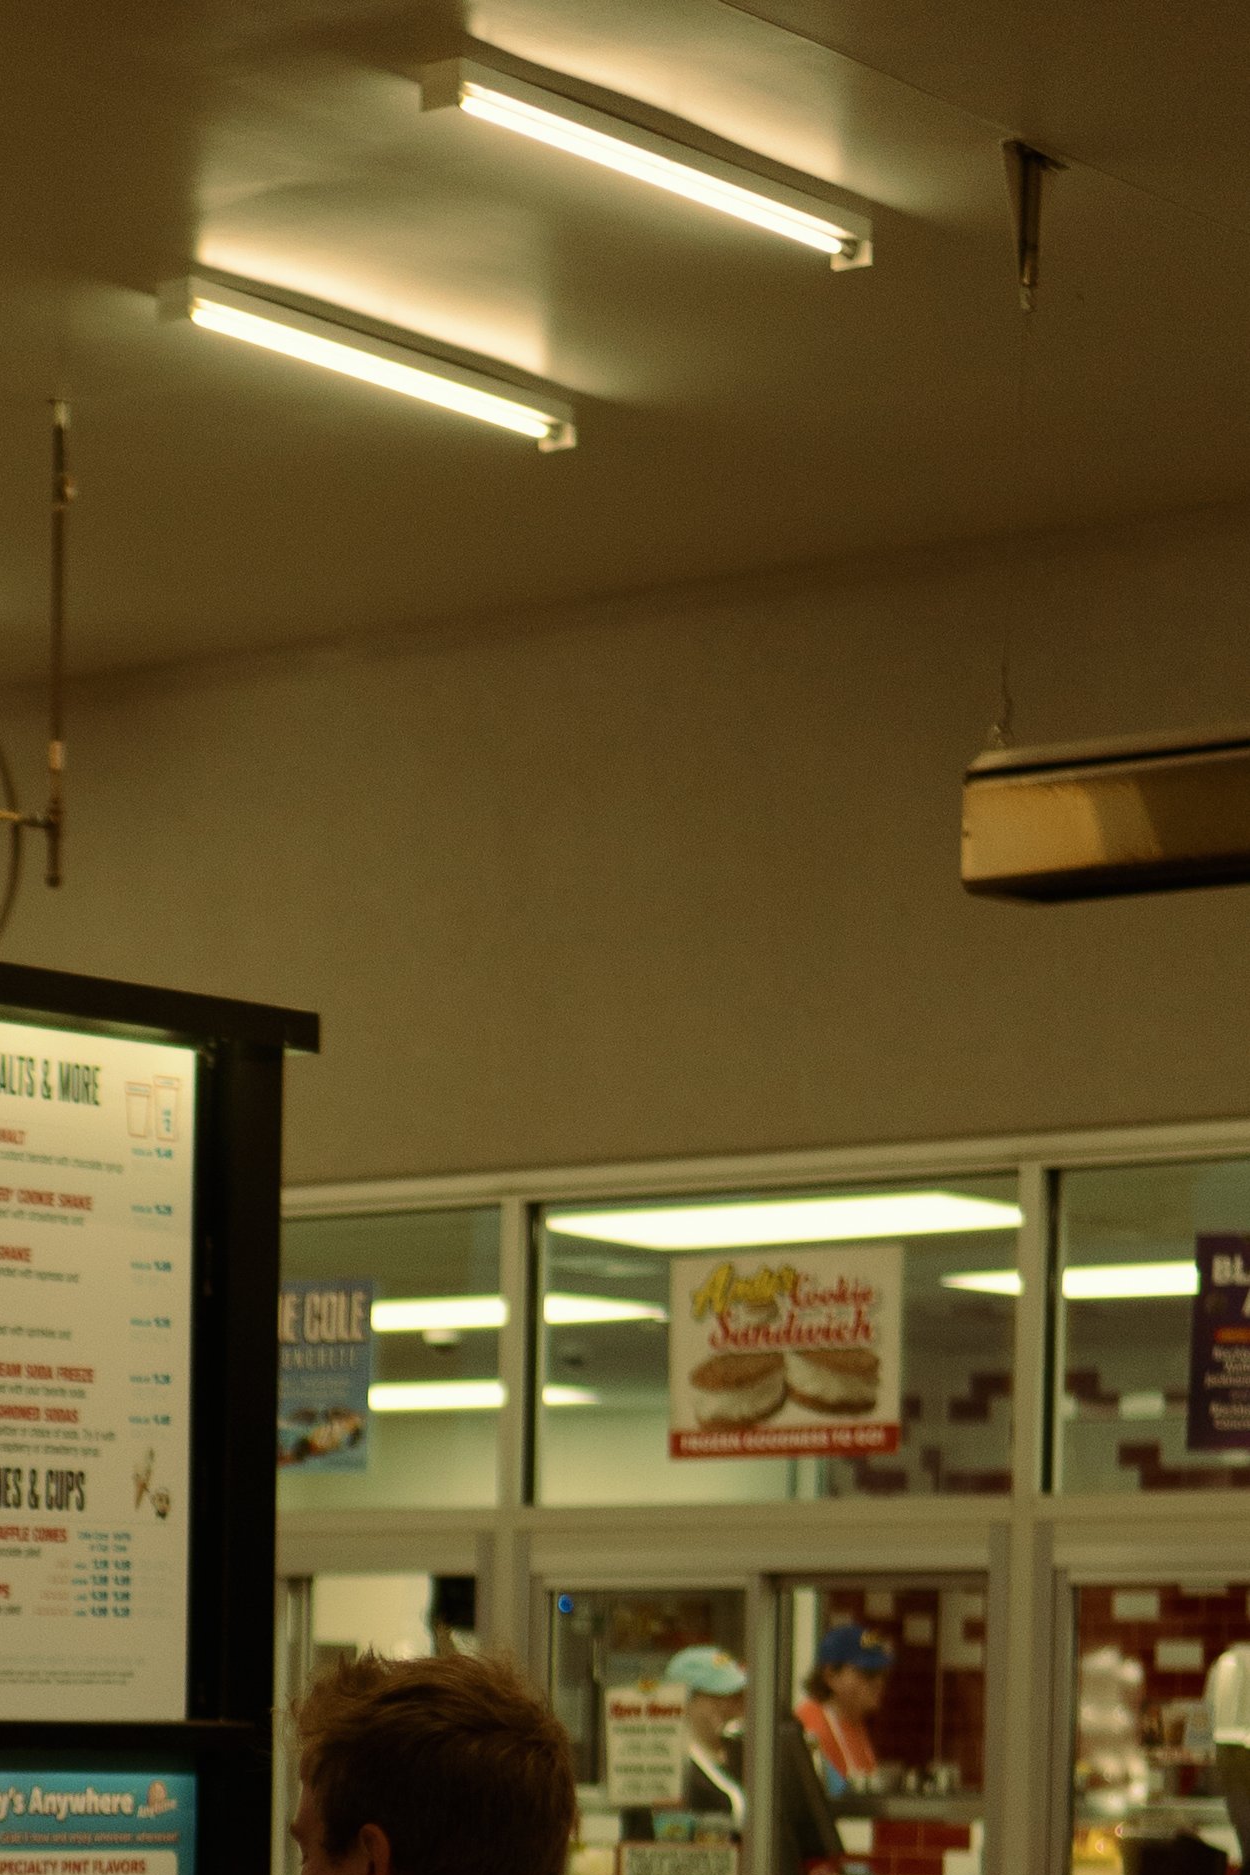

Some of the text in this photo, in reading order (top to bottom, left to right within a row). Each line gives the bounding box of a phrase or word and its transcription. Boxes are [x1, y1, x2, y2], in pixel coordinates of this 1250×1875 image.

[41, 1058, 53, 1100] &
[57, 1060, 101, 1107] MORE
[788, 1272, 873, 1307] Cookie
[708, 1307, 872, 1348] Sandwich
[27, 1467, 40, 1511] &
[45, 1468, 86, 1513] CUPS
[29, 1785, 134, 1821] Anywhere
[62, 1861, 89, 1875] PINT
[94, 1859, 145, 1875] FLAVORS
